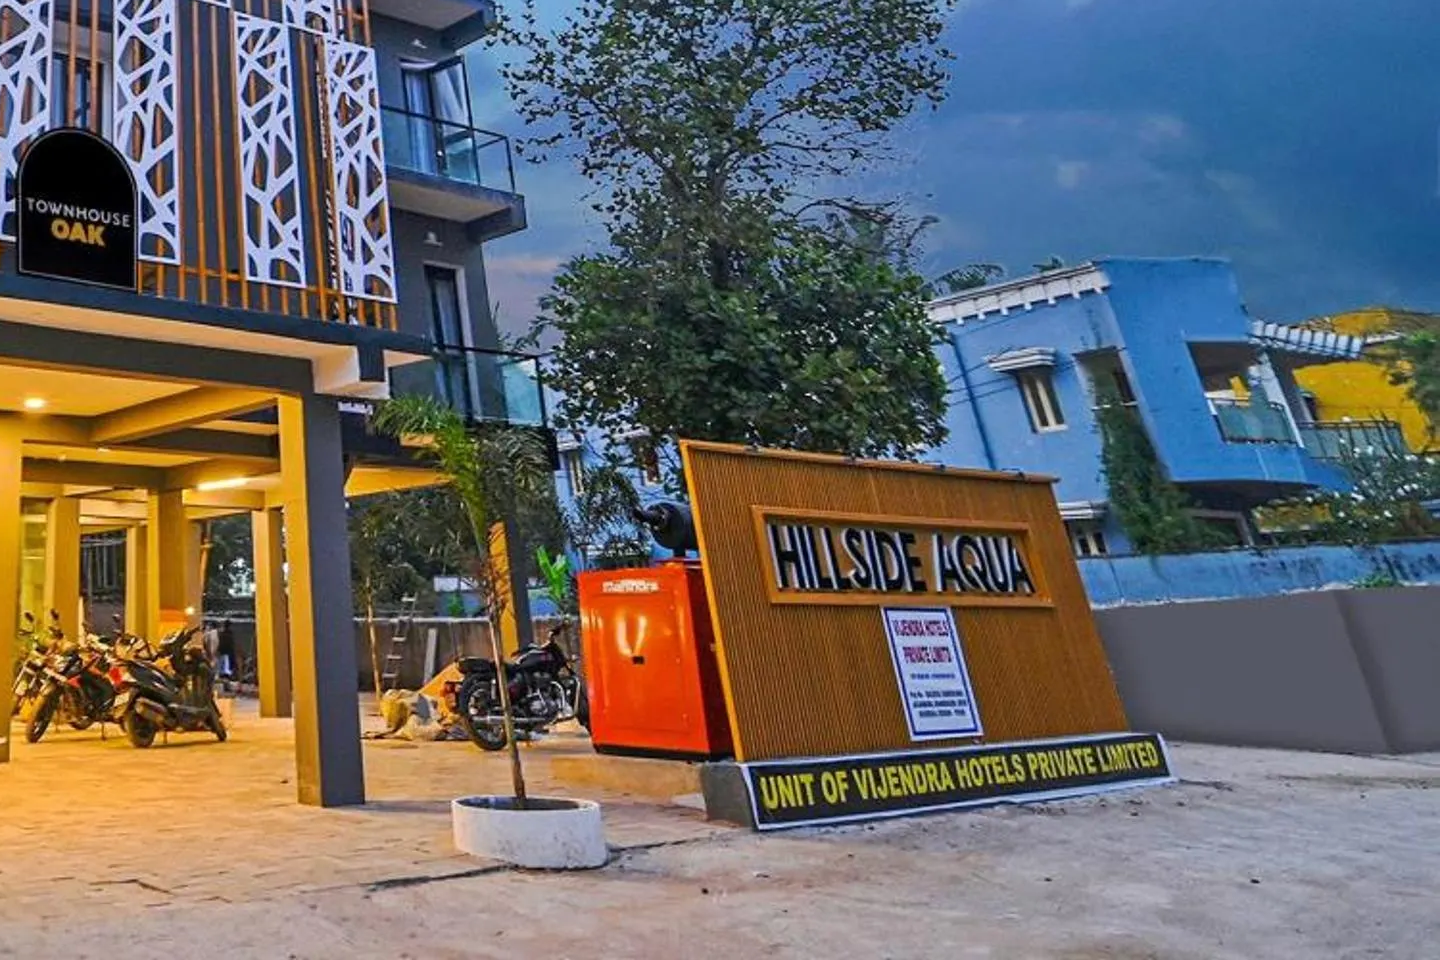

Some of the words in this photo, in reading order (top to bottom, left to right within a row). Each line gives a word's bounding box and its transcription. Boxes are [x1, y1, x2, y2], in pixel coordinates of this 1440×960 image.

[26, 197, 131, 228] TOWNHOUSE
[50, 218, 106, 246] OAK
[767, 523, 928, 593] HILLSIDE
[932, 532, 1036, 595] AQUA
[760, 775, 815, 810] UNIT
[819, 771, 850, 804] OF
[853, 763, 953, 801] VIJENDRA
[956, 755, 1026, 789] HOTELS
[1027, 747, 1097, 780] PRIVATE
[1097, 740, 1160, 772] LIMITED
